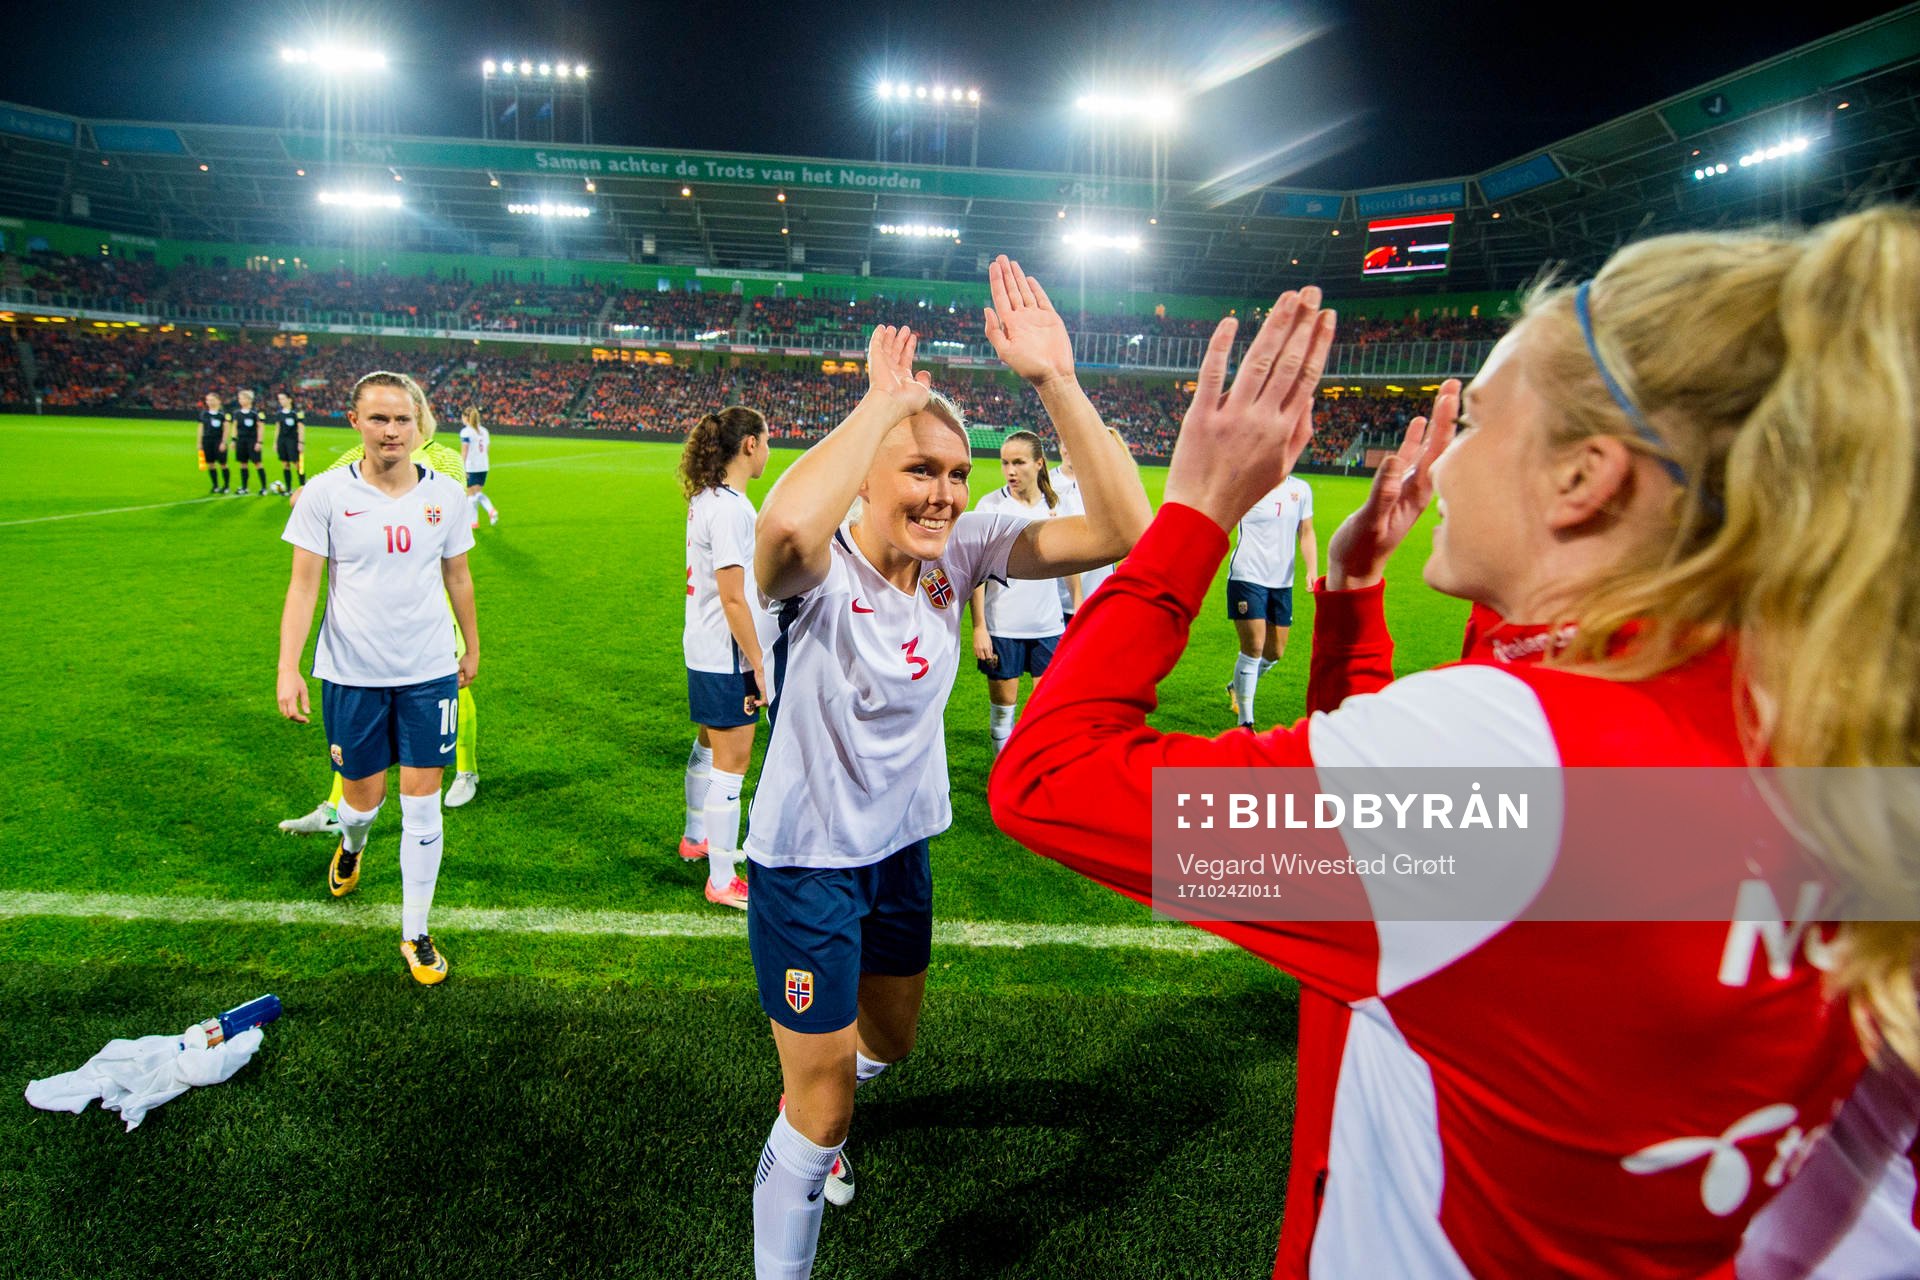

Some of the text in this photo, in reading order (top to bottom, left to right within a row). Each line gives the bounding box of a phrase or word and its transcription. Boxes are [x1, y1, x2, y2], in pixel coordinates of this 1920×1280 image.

[534, 152, 921, 189] Samen achter de Trots van het Noorden
[1275, 502, 1282, 517] 7
[383, 525, 411, 554] 10
[901, 636, 929, 680] 3
[438, 698, 458, 735] 10
